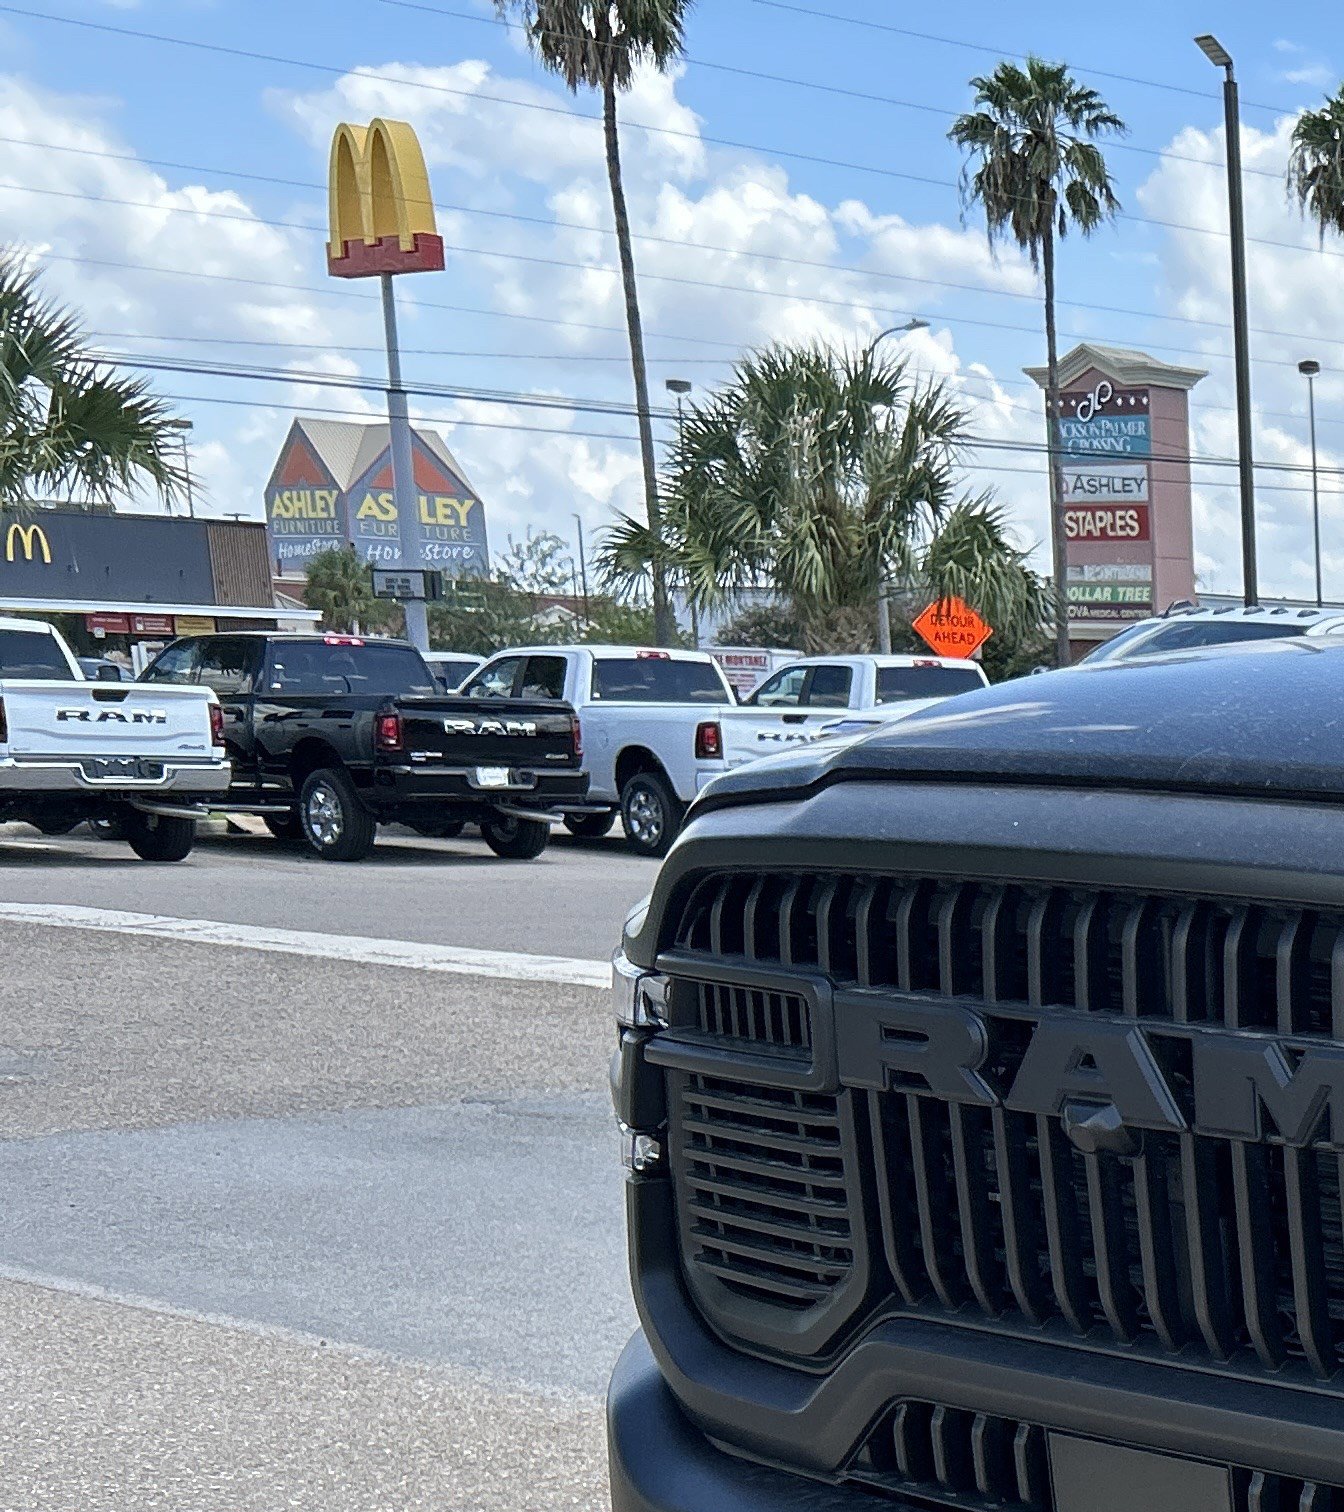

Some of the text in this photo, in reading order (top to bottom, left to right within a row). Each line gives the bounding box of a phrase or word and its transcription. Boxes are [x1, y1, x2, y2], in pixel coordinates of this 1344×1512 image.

[1072, 474, 1146, 494] ASHLEY
[271, 490, 339, 518] ASHLEY
[356, 493, 475, 527] ASLEY
[273, 520, 340, 534] FURNITURE
[360, 522, 472, 541] FURTURE
[1064, 510, 1140, 537] STAPLES
[1117, 587, 1152, 601] TREE
[1067, 606, 1089, 617] OVA
[930, 614, 975, 628] DETOUR
[934, 631, 975, 645] AHEAD
[56, 707, 167, 723] RAM
[444, 719, 537, 736] RAM
